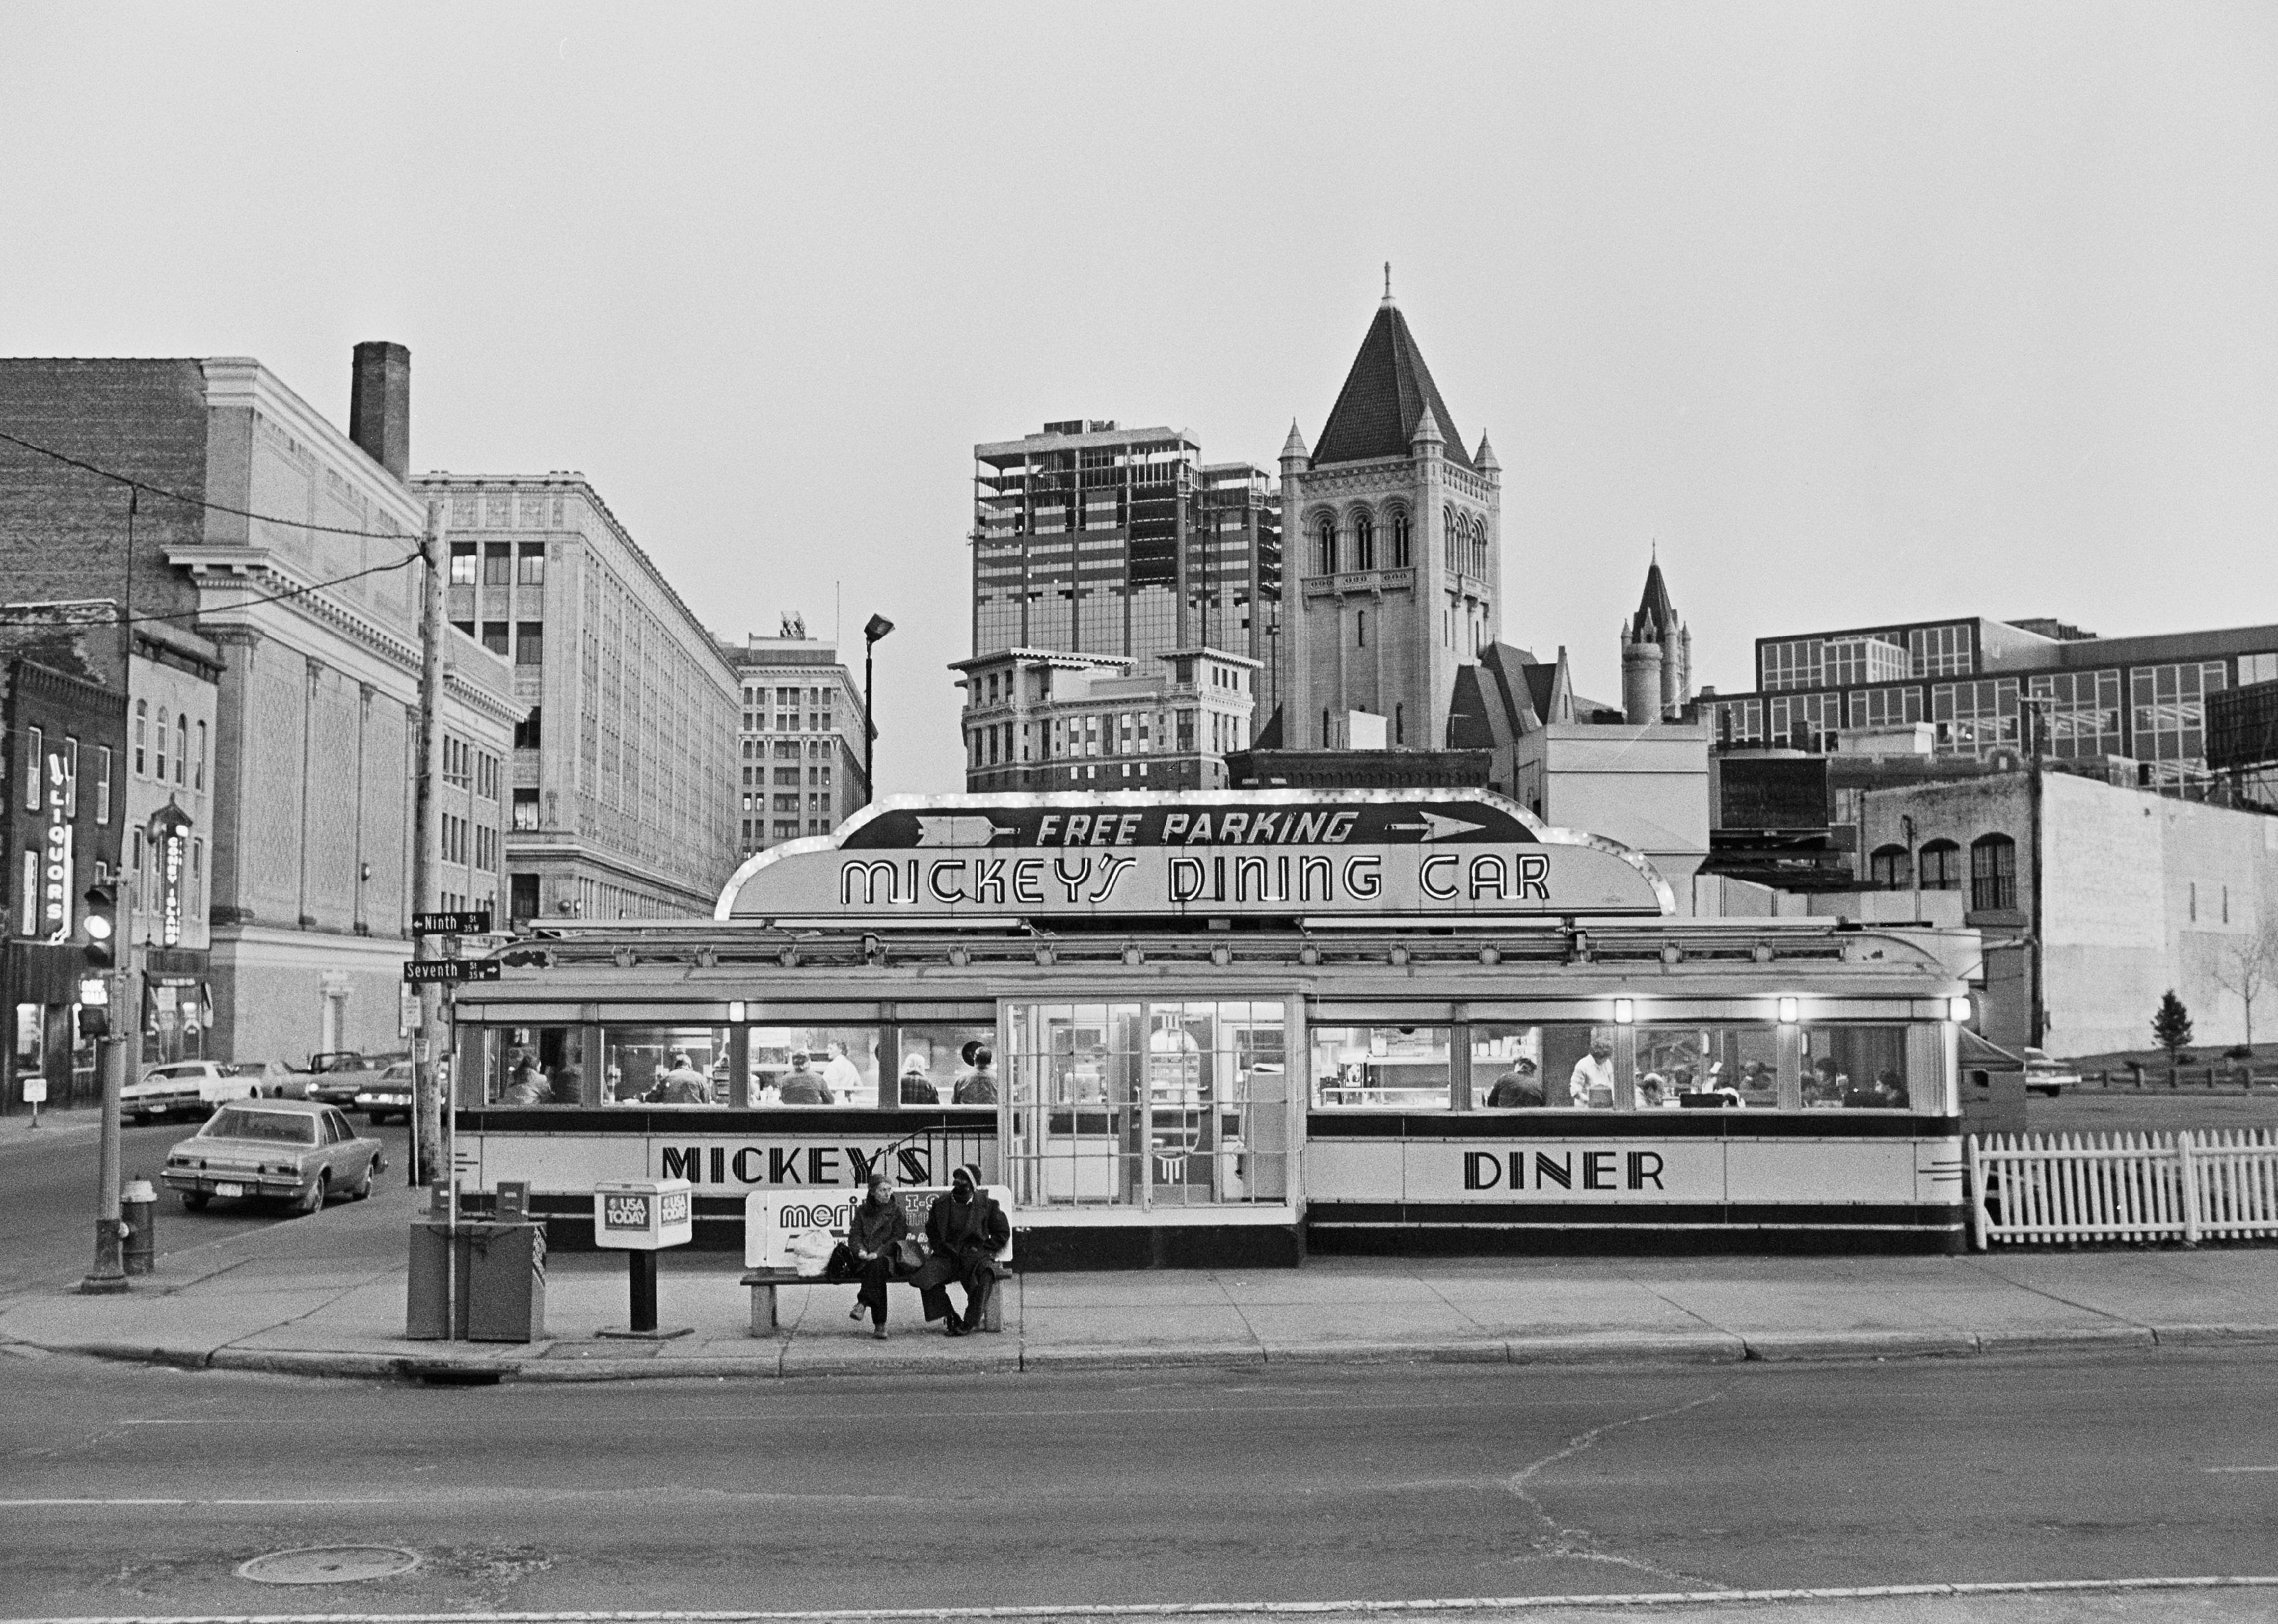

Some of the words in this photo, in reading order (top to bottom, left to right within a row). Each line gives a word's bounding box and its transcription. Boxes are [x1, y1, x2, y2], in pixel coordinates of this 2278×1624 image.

[1037, 814, 1143, 846] FREE
[1160, 811, 1359, 844] PARKING
[47, 790, 64, 919] LIQUORS
[841, 853, 1138, 903] MICKEY'S
[1168, 856, 1382, 902] DINING
[1419, 854, 1550, 900] CAR
[425, 915, 457, 930] Ninth
[407, 962, 458, 977] Seventh
[1464, 1152, 1664, 1190] DINER
[620, 1197, 645, 1211] USA
[670, 1194, 686, 1210] USA
[780, 1196, 858, 1227] meri
[607, 1209, 647, 1225] TODAY
